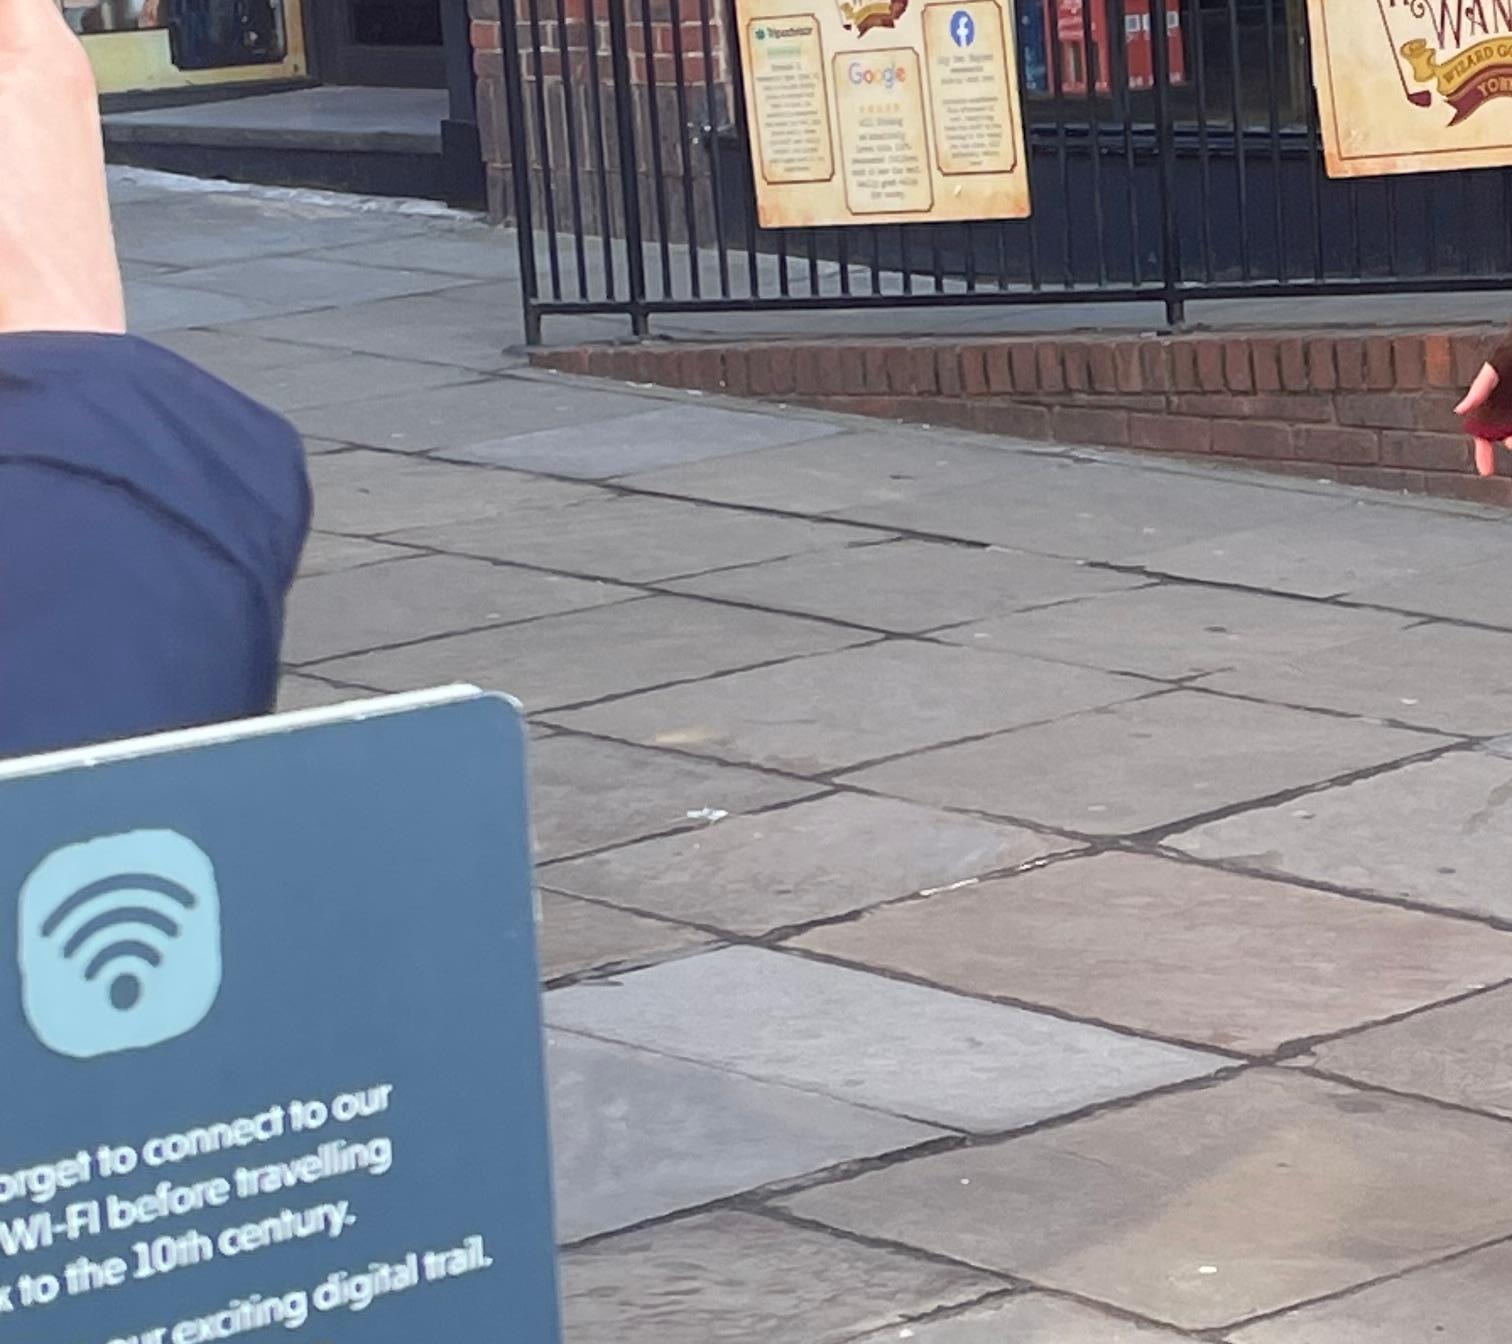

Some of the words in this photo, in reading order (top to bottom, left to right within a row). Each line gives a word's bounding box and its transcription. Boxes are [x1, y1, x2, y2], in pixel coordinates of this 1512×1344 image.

[1443, 45, 1495, 83] WIZARD
[0, 1149, 92, 1204] orget
[97, 1144, 137, 1178] to
[142, 1104, 285, 1167] connect
[288, 1099, 329, 1132] to
[331, 1083, 393, 1123] our
[106, 1176, 231, 1231] before
[232, 1136, 393, 1199] travelling
[18, 1274, 60, 1307] to
[65, 1256, 128, 1296] the
[132, 1228, 213, 1278] 10th
[217, 1200, 357, 1257] century.
[312, 1252, 418, 1312] digital
[422, 1235, 494, 1282] trail.
